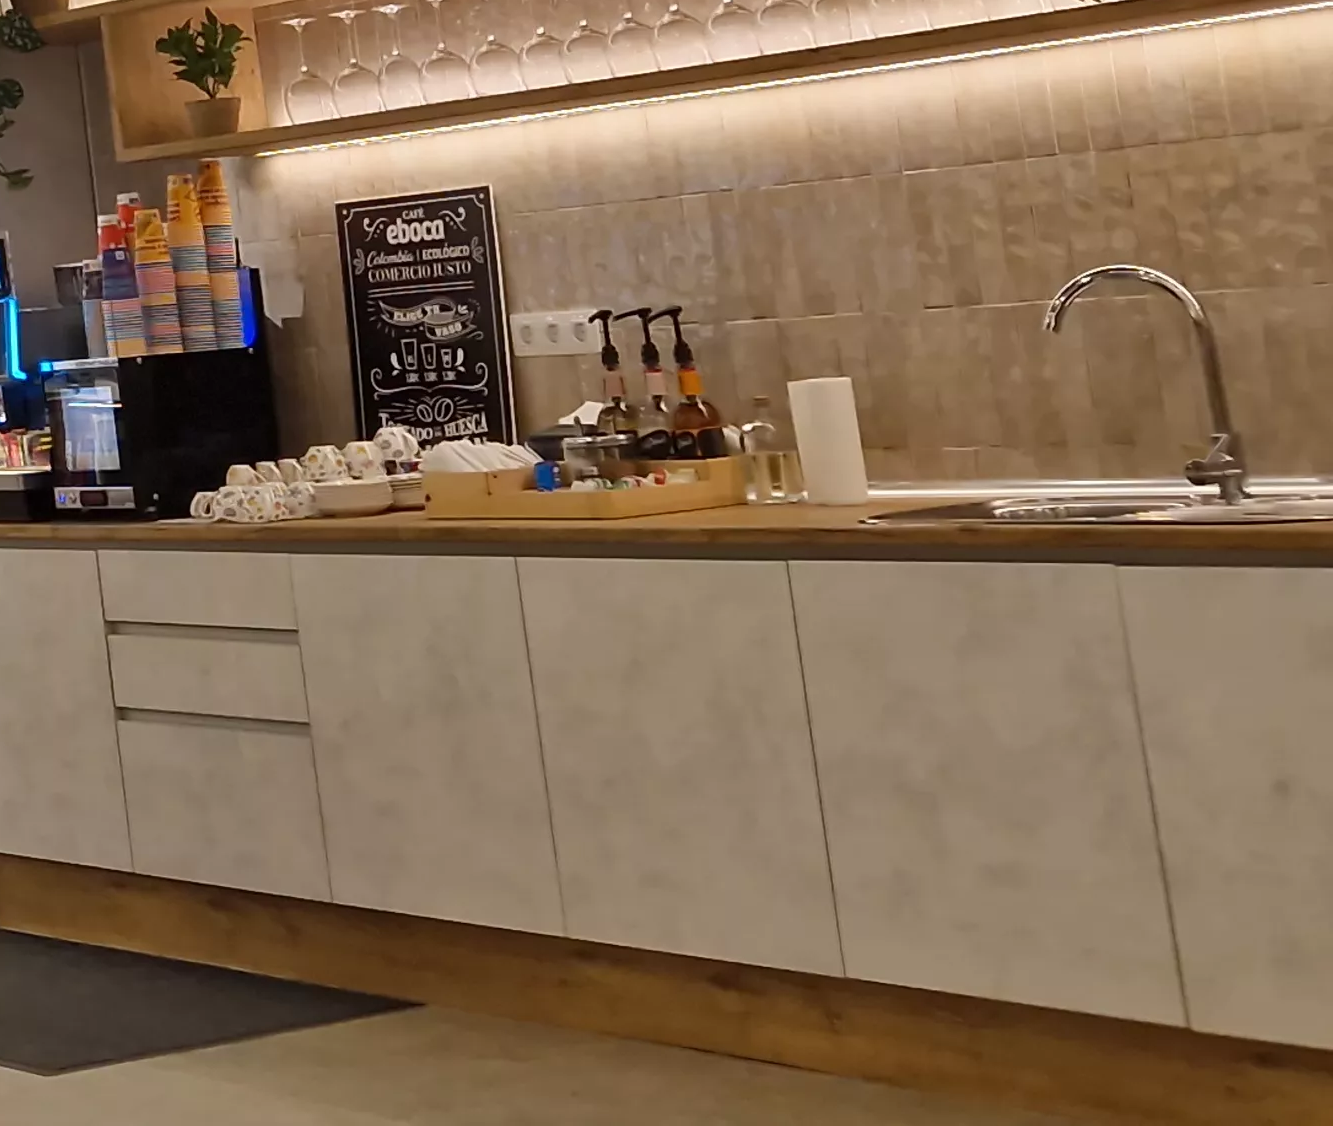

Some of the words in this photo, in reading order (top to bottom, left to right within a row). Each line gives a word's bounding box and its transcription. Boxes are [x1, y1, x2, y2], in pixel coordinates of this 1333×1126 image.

[386, 218, 445, 245] eboca
[367, 249, 415, 268] Colombia
[422, 243, 470, 260] ECOLÓGICO
[368, 264, 431, 283] COMERCIO
[432, 261, 471, 278] JUSTO
[444, 411, 488, 437] HUESCA
